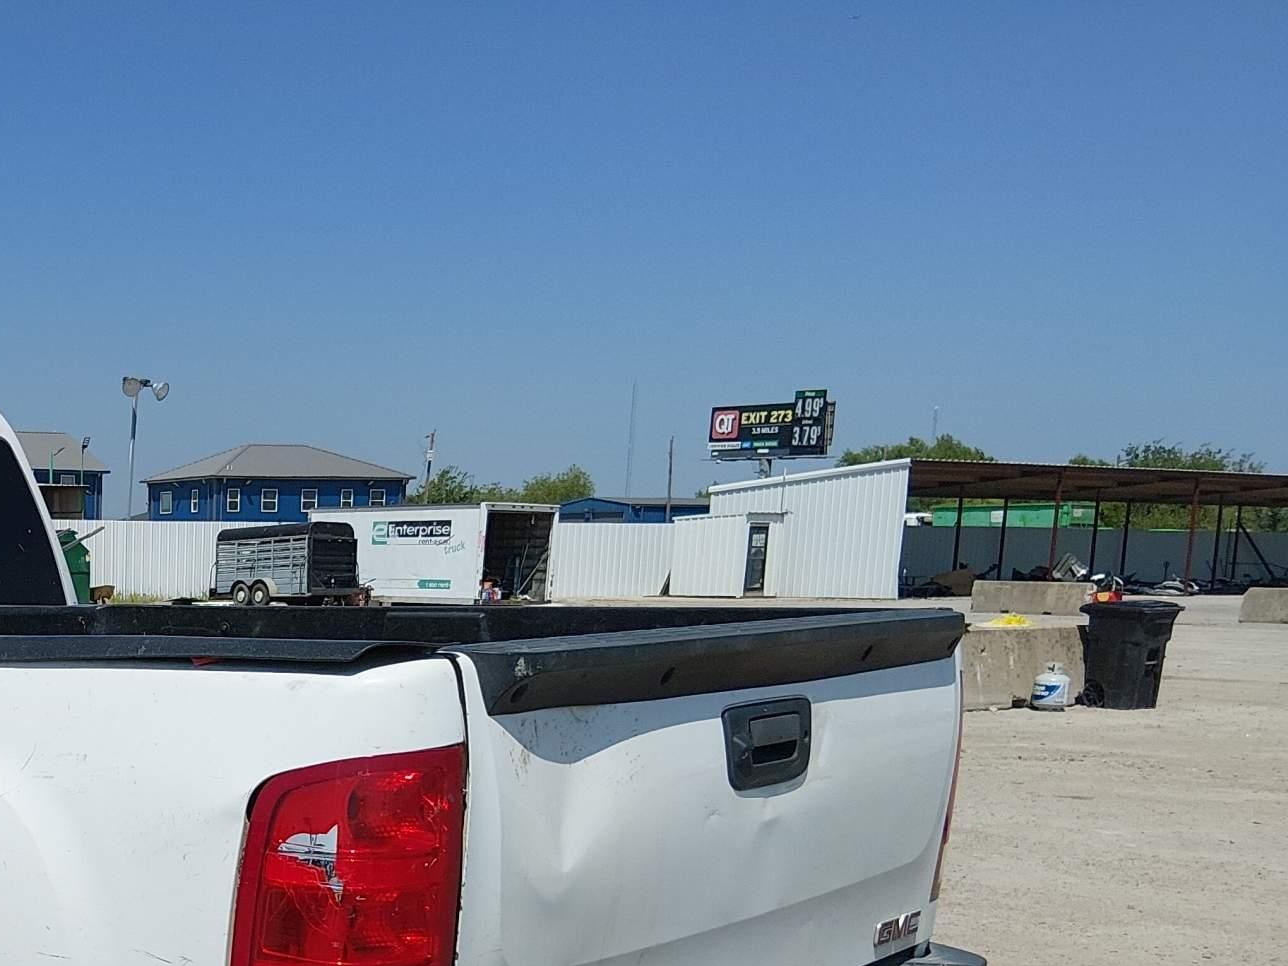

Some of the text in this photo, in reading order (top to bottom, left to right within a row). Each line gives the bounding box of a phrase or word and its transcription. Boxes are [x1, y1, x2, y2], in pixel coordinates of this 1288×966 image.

[715, 414, 735, 435] QT
[741, 411, 768, 425] EXIT
[770, 410, 792, 423] 273
[761, 426, 779, 434] MILES
[388, 522, 451, 539] Enterprise
[444, 540, 466, 555] truck
[873, 910, 922, 947] GMC
